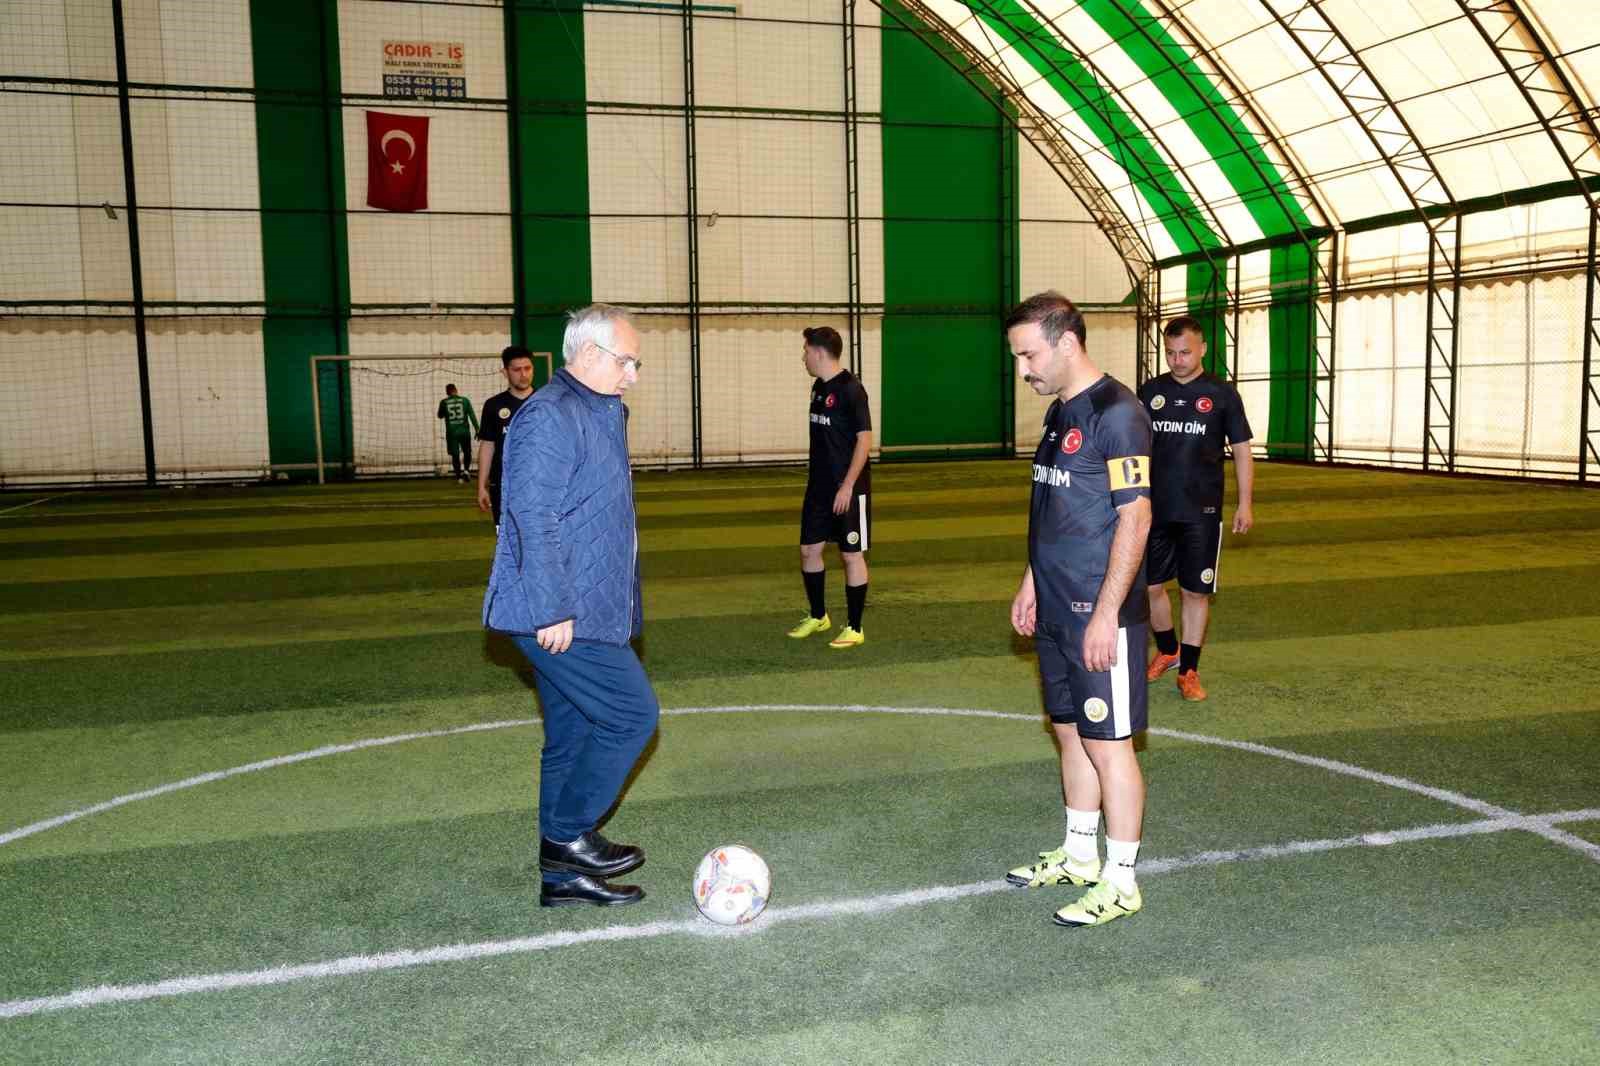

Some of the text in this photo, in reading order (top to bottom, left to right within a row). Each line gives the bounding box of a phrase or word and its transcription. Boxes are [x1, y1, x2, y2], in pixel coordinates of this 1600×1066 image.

[385, 76, 411, 85] 0534
[386, 87, 411, 95] 0212
[414, 88, 433, 96] 690
[448, 404, 464, 419] 53
[1122, 458, 1141, 484] C
